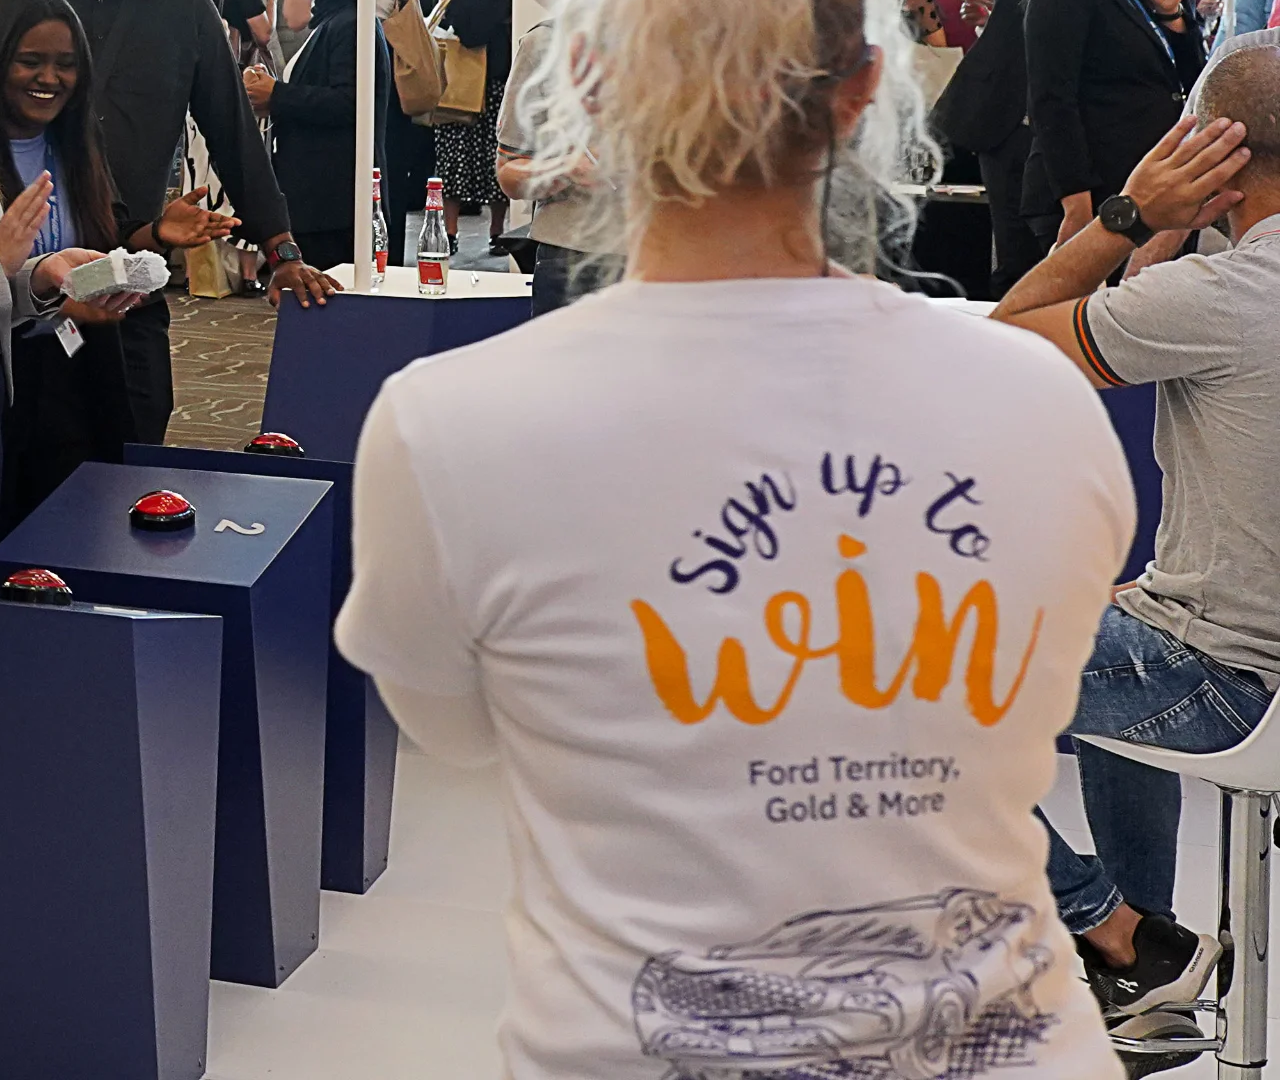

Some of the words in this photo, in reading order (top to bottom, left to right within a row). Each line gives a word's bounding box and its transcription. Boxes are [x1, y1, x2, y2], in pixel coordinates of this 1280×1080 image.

[213, 518, 266, 535] 2
[670, 474, 797, 595] Sign
[821, 452, 913, 518] up
[925, 471, 993, 562] to
[630, 533, 1045, 728] win
[749, 757, 819, 787] Ford
[828, 753, 961, 785] Territory,
[765, 794, 837, 823] Gold
[846, 793, 871, 819] &
[878, 791, 945, 817] More
